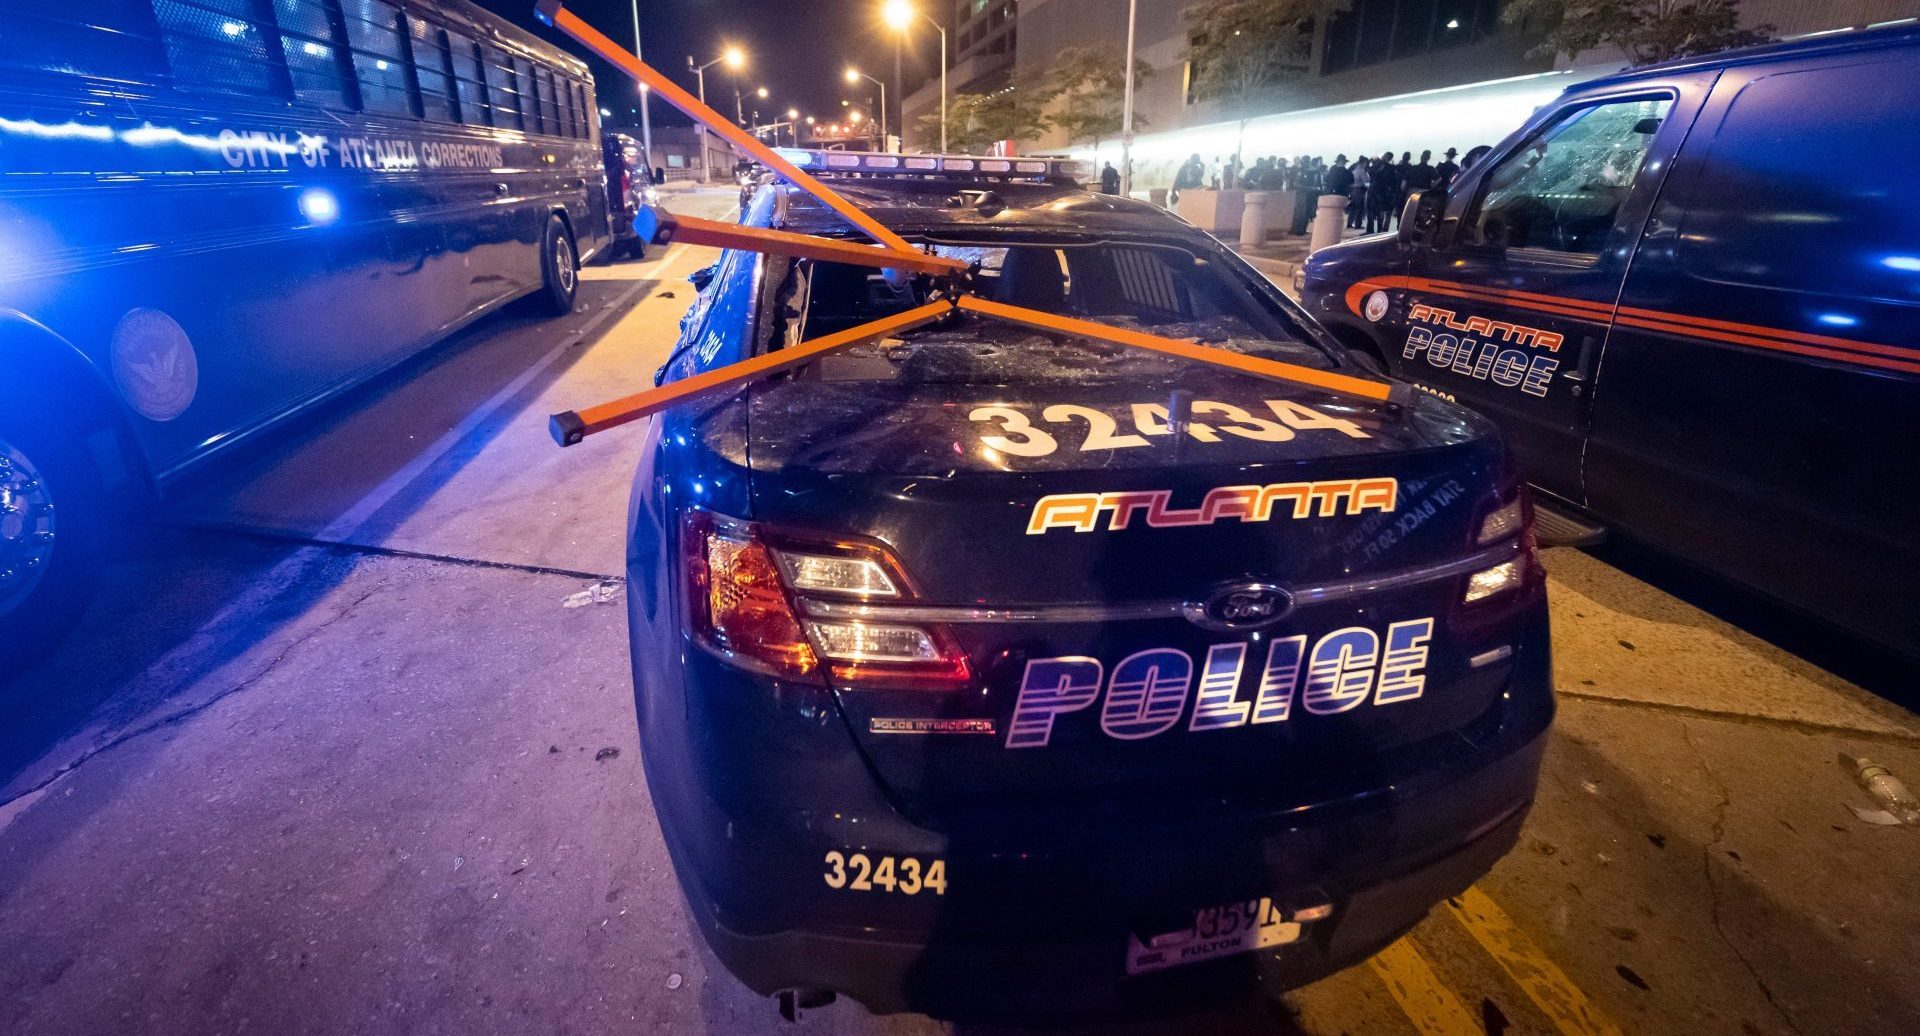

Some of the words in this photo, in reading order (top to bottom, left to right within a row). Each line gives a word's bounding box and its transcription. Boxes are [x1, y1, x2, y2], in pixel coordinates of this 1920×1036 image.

[219, 128, 288, 168] CITY
[301, 134, 330, 168] OF
[340, 137, 419, 169] ATLANTA
[421, 141, 503, 169] CORRECTIONS
[1408, 303, 1564, 352] ATLANTA
[1402, 326, 1560, 397] POLICE
[968, 399, 1374, 457] 32434
[1025, 477, 1398, 535] ATLANTA
[1223, 592, 1275, 618] Ford
[1003, 617, 1435, 749] POLICE
[873, 720, 913, 730] POLICE
[916, 720, 992, 731] INTERCEPTOR
[824, 850, 948, 895] 32434
[1181, 937, 1241, 958] FULTON
